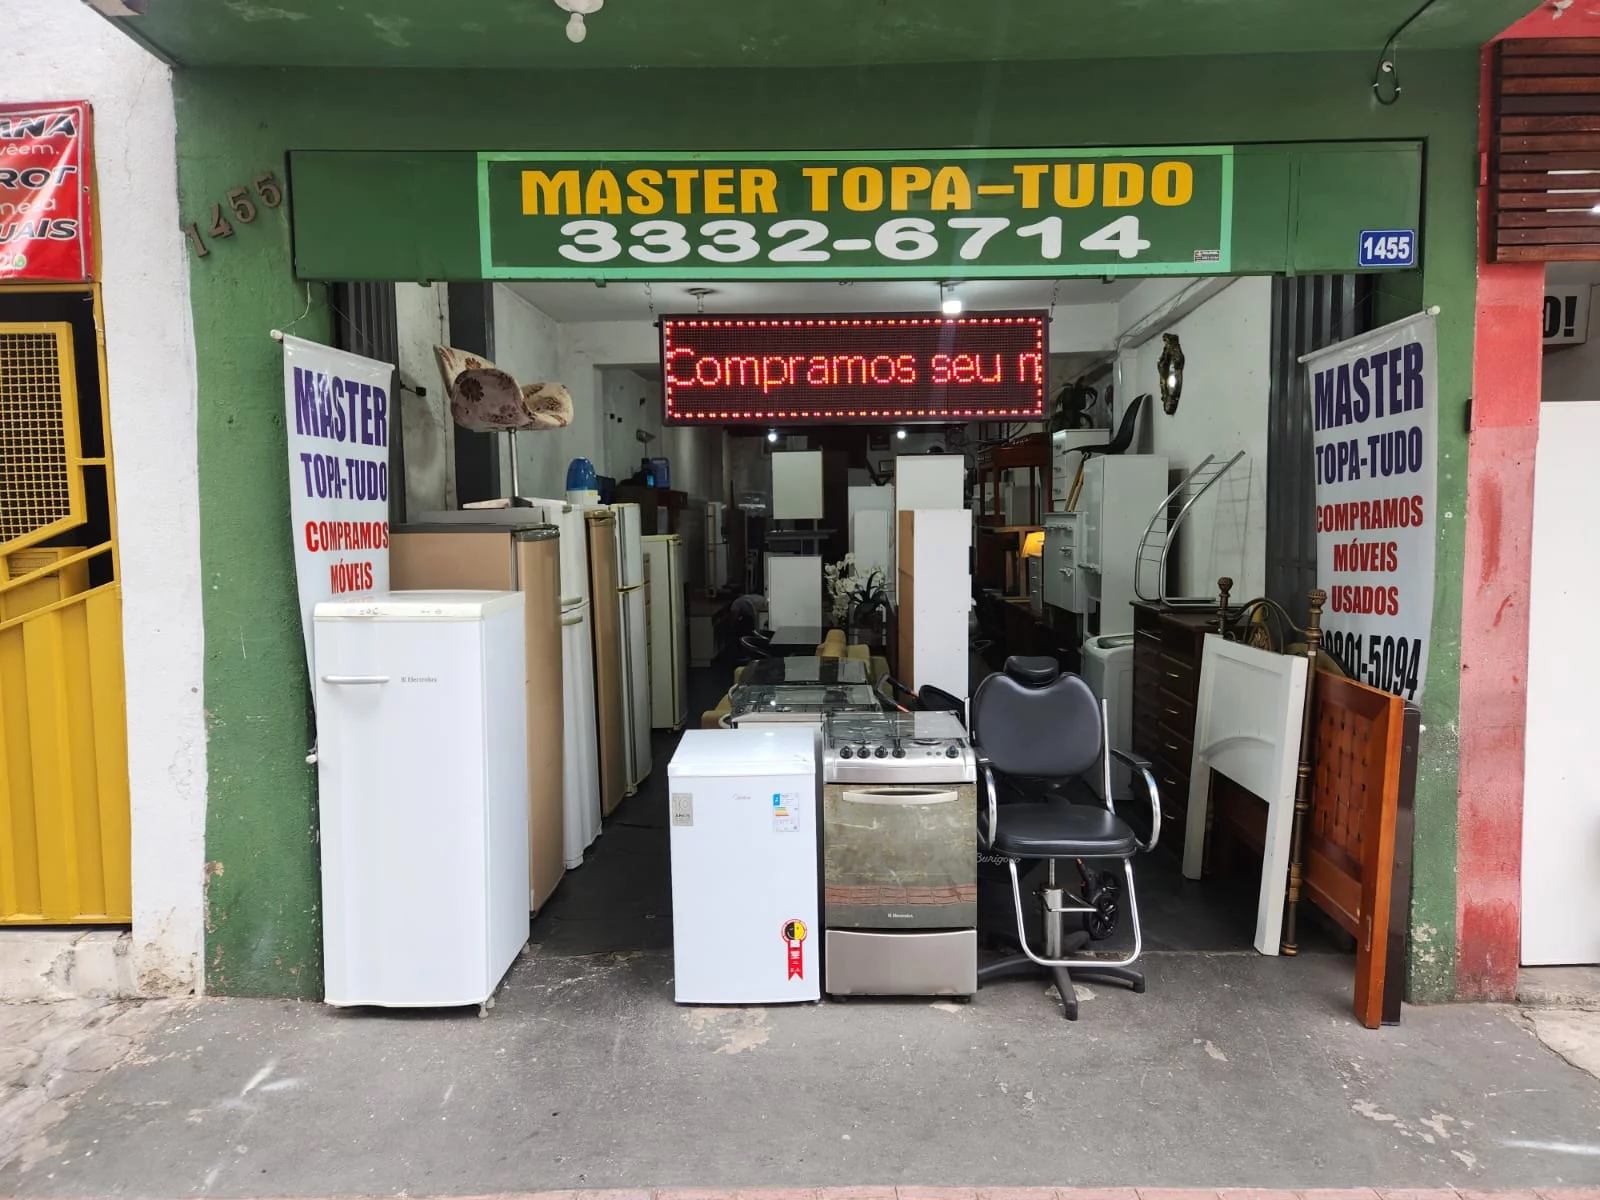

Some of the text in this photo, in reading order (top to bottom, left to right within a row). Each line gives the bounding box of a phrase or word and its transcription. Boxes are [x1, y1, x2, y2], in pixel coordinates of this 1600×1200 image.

[521, 161, 1194, 215] MASTER TOPA-TUDO
[187, 171, 281, 258] 1455
[558, 215, 1151, 263] 3332-6714
[1364, 236, 1410, 260] 1455
[667, 348, 916, 394] Compramos
[931, 354, 1001, 383] seu
[1314, 342, 1424, 432] MASTER
[293, 366, 388, 448] MASTER
[300, 452, 388, 502] TOPA-TUDO
[1315, 426, 1423, 485] TOPA-TUDO
[305, 520, 389, 553] COMPRAMOS
[1316, 495, 1424, 533] COMPRAMOS
[330, 558, 373, 595] MÓVEIS
[1333, 538, 1398, 572] MÓVEIS
[1331, 585, 1399, 616] USADOS
